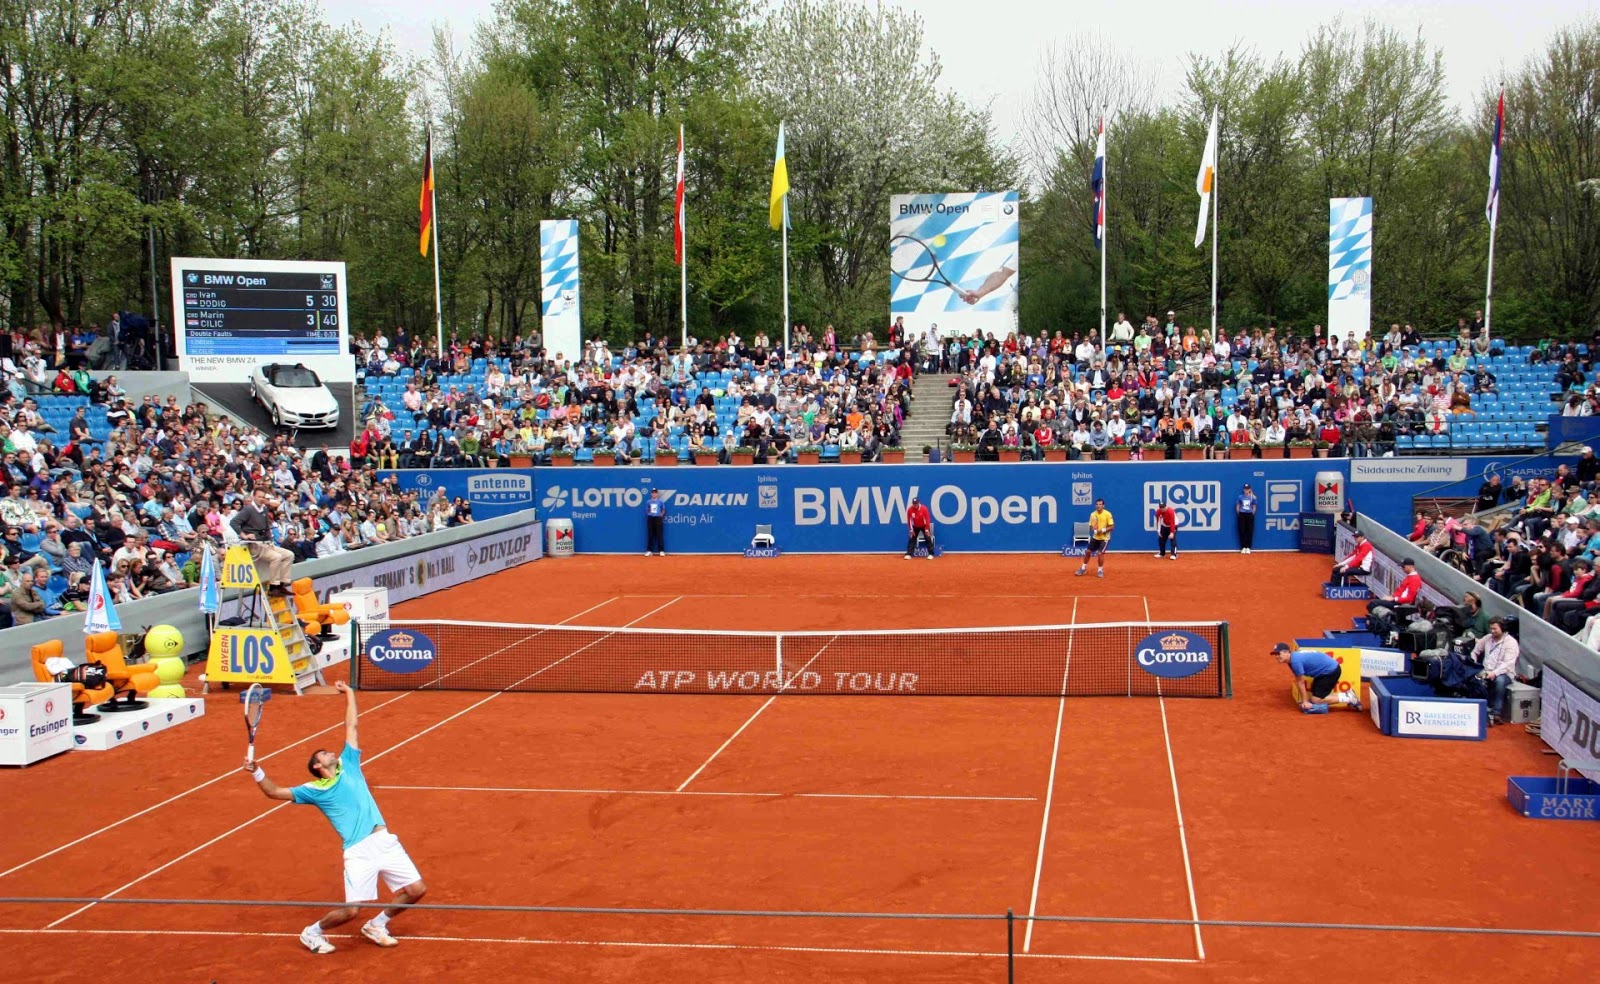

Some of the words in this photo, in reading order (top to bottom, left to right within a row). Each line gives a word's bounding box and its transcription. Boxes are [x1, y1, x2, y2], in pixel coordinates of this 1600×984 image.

[899, 203, 933, 215] BMW
[936, 203, 970, 216] Open
[204, 274, 234, 285] BMW
[236, 275, 267, 287] Open
[199, 291, 217, 299] Ivan
[306, 295, 314, 307] 5
[321, 295, 337, 307] 30
[199, 299, 227, 307] DODIG
[200, 311, 225, 319] Marin
[306, 314, 315, 326] 3
[322, 314, 338, 326] 40
[200, 320, 224, 328] CILIC
[1071, 472, 1093, 480] Iphitos
[1356, 464, 1416, 474] Süddeutsche
[1416, 464, 1453, 476] Zeitung
[473, 478, 526, 489] antenne
[571, 487, 643, 508] LOTTO
[674, 493, 749, 506] DAIKIN
[1148, 483, 1216, 505] LIQUI
[572, 511, 597, 519] Bayern
[794, 486, 920, 526] BMW
[930, 485, 1058, 534] Open
[662, 513, 697, 526] eading
[699, 513, 714, 524] Air
[1148, 507, 1218, 528] OLY
[1265, 518, 1300, 531] FILA
[478, 534, 532, 565] DUNLOP
[746, 549, 774, 557] GUINOT
[441, 555, 455, 576] BALL
[505, 555, 526, 567] SPORT
[231, 563, 253, 584] LOS
[1330, 588, 1367, 599] GUINOT
[221, 634, 229, 672] BAYERN
[230, 634, 275, 675] LOS
[369, 645, 433, 662] Corona
[1137, 648, 1209, 666] Corona
[634, 671, 696, 689] ATP
[706, 670, 822, 690] WORLD
[834, 672, 920, 691] TOUR
[1405, 711, 1422, 725] BR
[1423, 711, 1472, 720] BAYERISCHES
[30, 717, 69, 738] Ensinger
[1423, 719, 1467, 727] FERNSEHEN
[1542, 796, 1596, 809] MARY
[1540, 806, 1596, 819] COHR
